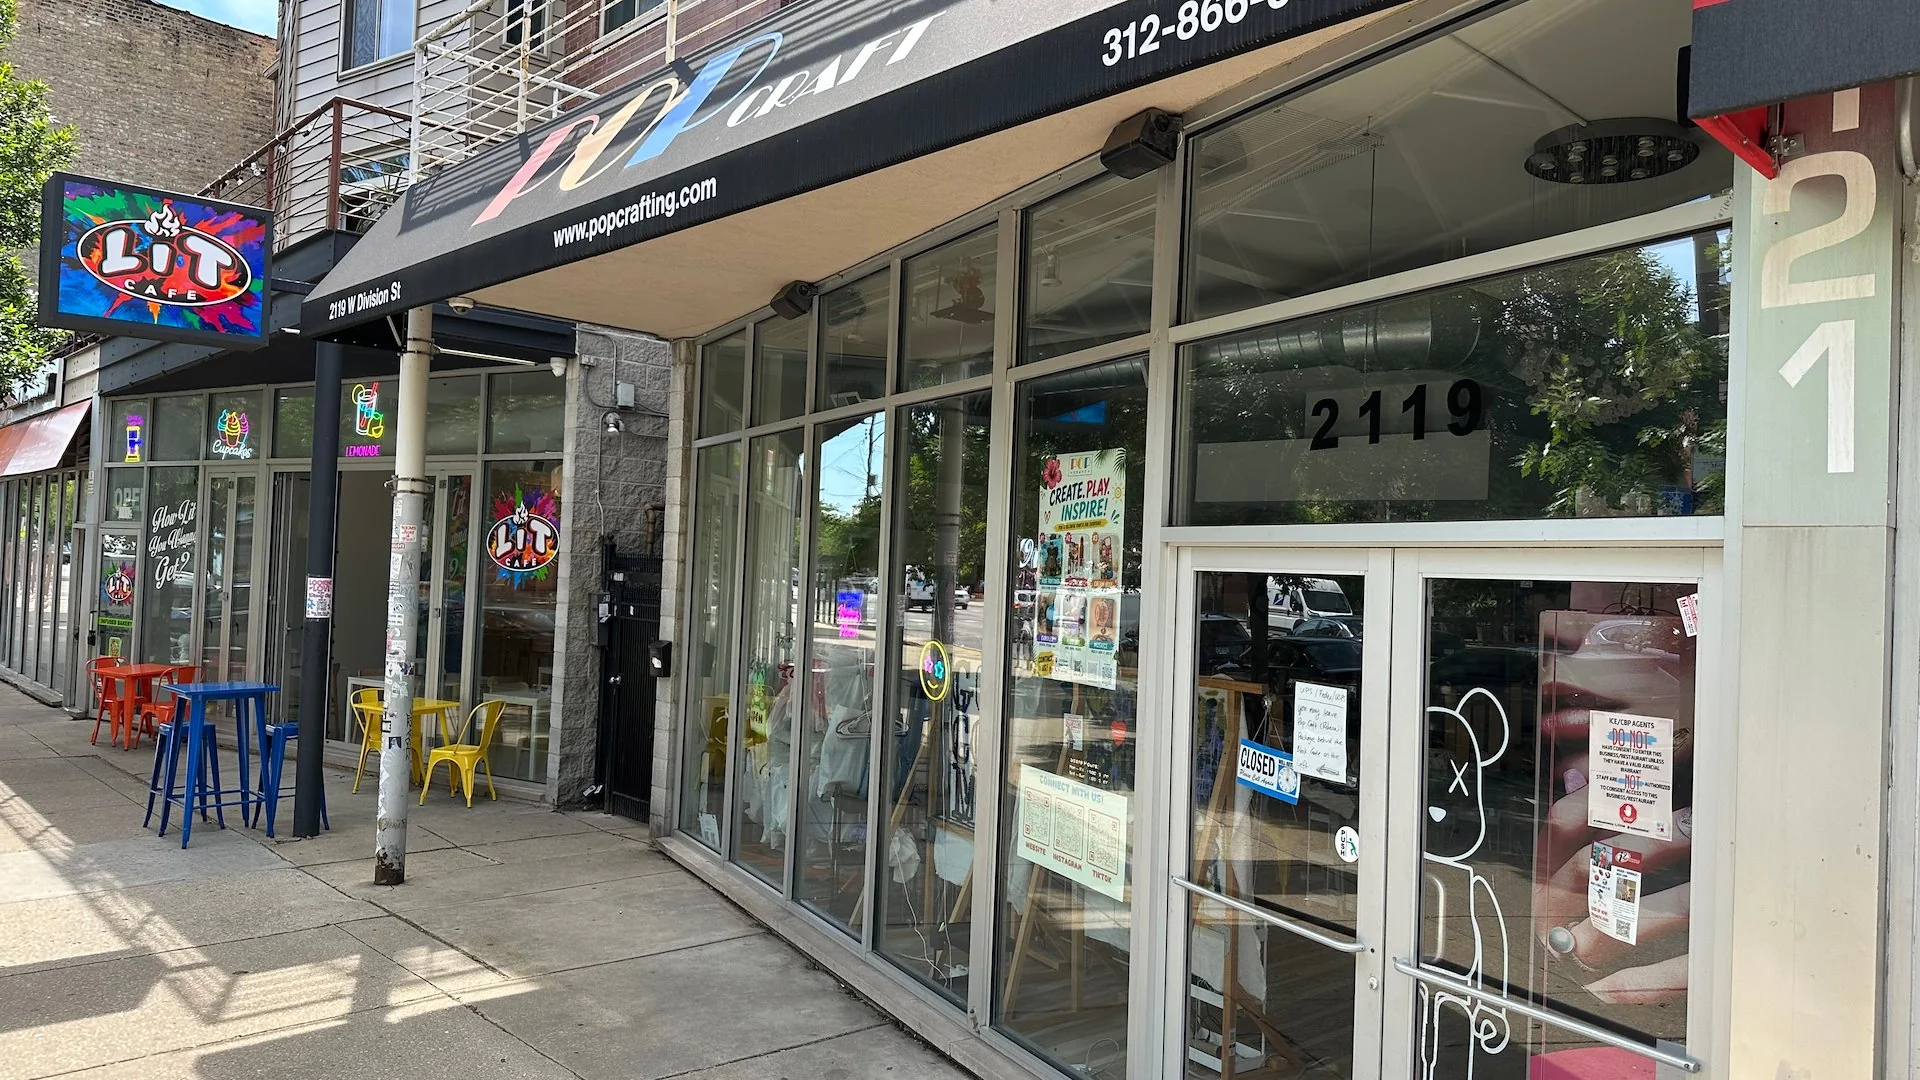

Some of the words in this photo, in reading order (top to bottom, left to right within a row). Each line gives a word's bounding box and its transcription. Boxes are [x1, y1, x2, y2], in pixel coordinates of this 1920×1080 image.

[470, 32, 784, 226] POP
[727, 9, 947, 128] CRAFT
[553, 176, 717, 248] www.popcrafting.com
[124, 279, 197, 301] CAFE
[328, 298, 346, 320] 2119
[347, 295, 357, 315] W
[356, 287, 389, 312] Division
[390, 281, 402, 301] St
[1309, 378, 1482, 451] 2119
[212, 439, 253, 460] Cupcakes
[345, 444, 381, 457] LEMONADE
[1070, 457, 1090, 470] POP
[1049, 481, 1085, 507] CREATE.
[1086, 477, 1110, 498] PLAY.
[152, 505, 177, 533] How
[177, 499, 197, 526] Lit
[1061, 498, 1109, 522] INSPIRE!
[148, 535, 168, 558] You
[505, 557, 537, 568] CAFE
[1609, 717, 1632, 726] ICE/CBP
[1632, 720, 1655, 729] AGENTS
[1612, 728, 1625, 747] DO
[1629, 729, 1650, 750] NOT
[1240, 747, 1275, 777] CLOSED
[1638, 749, 1652, 757] ENTER
[1620, 767, 1642, 775] WARRANT
[1641, 763, 1660, 771] JUDICIAL
[1040, 774, 1070, 793] CONNECT
[1071, 783, 1090, 799] WITH
[1091, 793, 1104, 805] US!
[1624, 774, 1641, 790] NOT
[1644, 782, 1671, 791] AUTHORIZED
[1625, 789, 1641, 797] ACCESS
[1606, 792, 1656, 805] BUSINESS/RESTAURANT
[1025, 841, 1046, 856] WEBSITE
[1052, 852, 1083, 871] INSTAGRAM
[1092, 869, 1112, 884] TIKTOK
